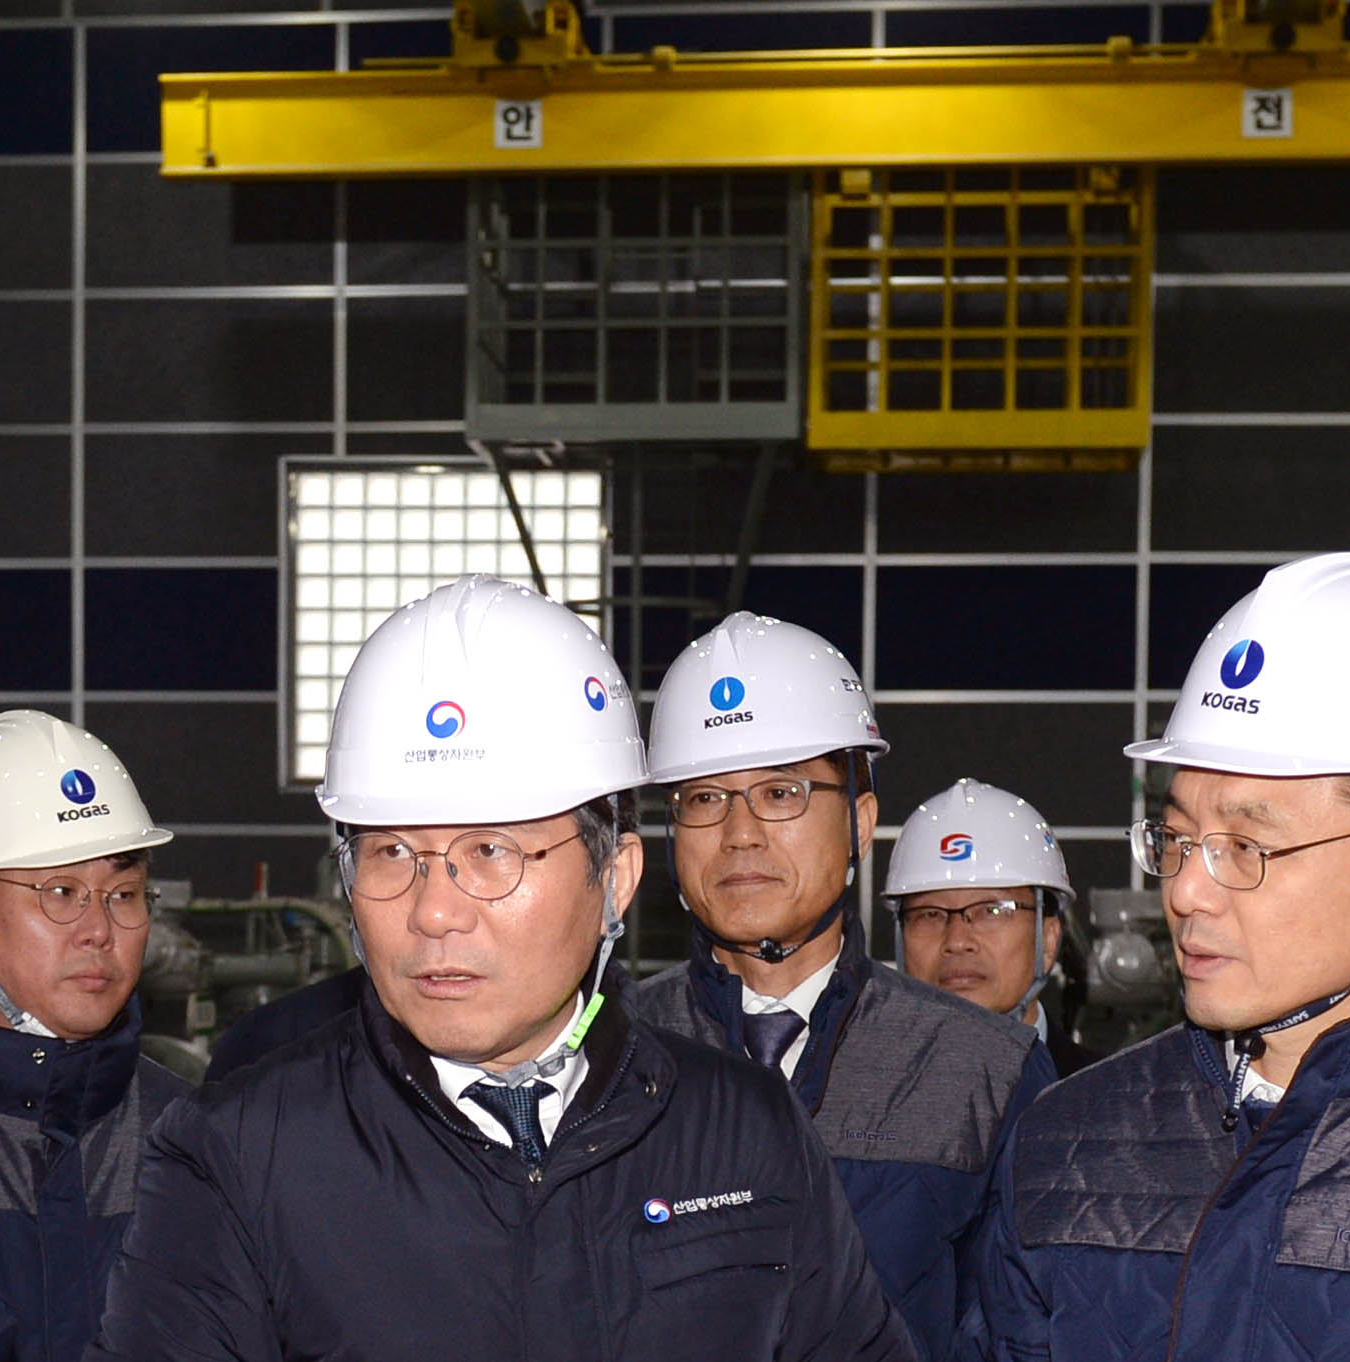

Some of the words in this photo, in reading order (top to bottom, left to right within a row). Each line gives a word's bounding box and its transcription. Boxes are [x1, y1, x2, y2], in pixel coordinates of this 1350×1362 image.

[502, 105, 535, 142] 안
[1252, 95, 1283, 131] 전
[672, 1190, 754, 1216] 산업통상자원부
